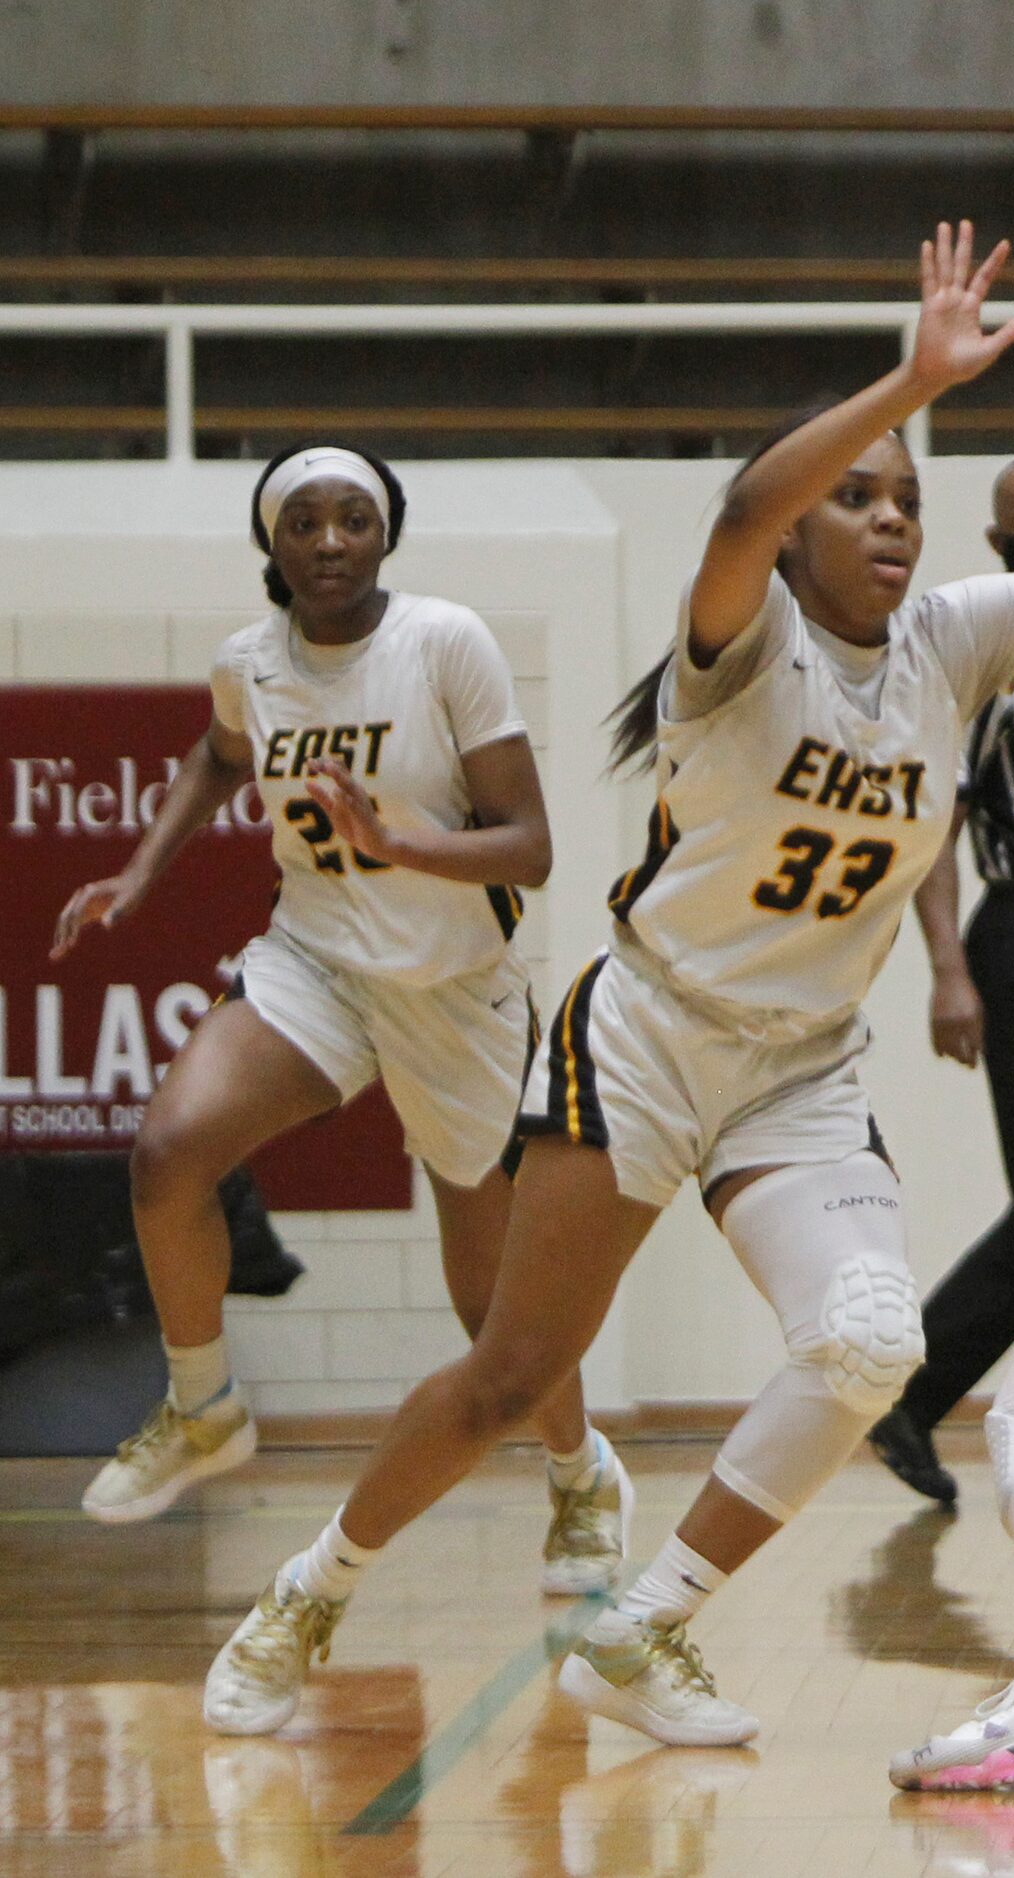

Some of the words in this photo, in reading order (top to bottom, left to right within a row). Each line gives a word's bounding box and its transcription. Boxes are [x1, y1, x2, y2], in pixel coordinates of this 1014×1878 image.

[262, 720, 393, 780] EAST
[774, 735, 926, 821] EAST
[750, 823, 896, 919] 33
[12, 1104, 105, 1133] SCHOOL
